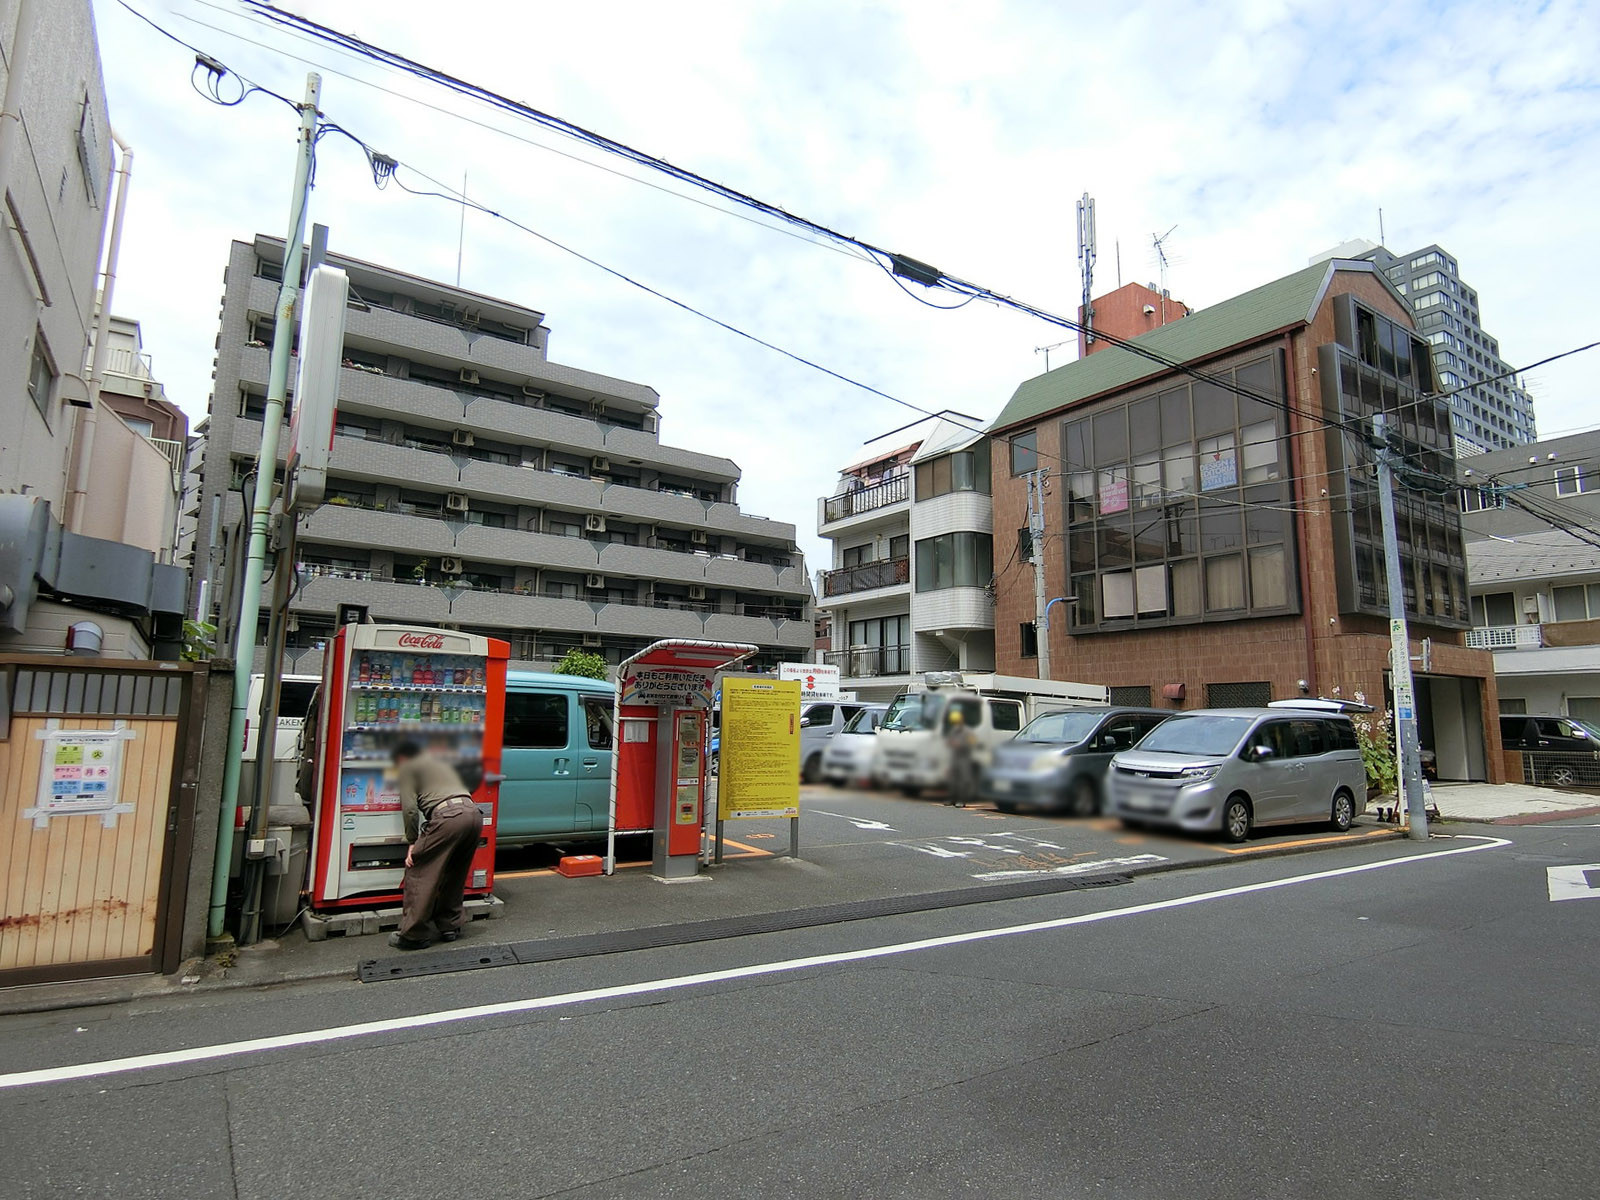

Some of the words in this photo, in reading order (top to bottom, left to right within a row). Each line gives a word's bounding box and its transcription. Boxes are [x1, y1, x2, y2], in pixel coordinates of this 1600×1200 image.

[398, 632, 446, 650] Coca-Cola
[636, 671, 706, 682] 本日もご利用いただき
